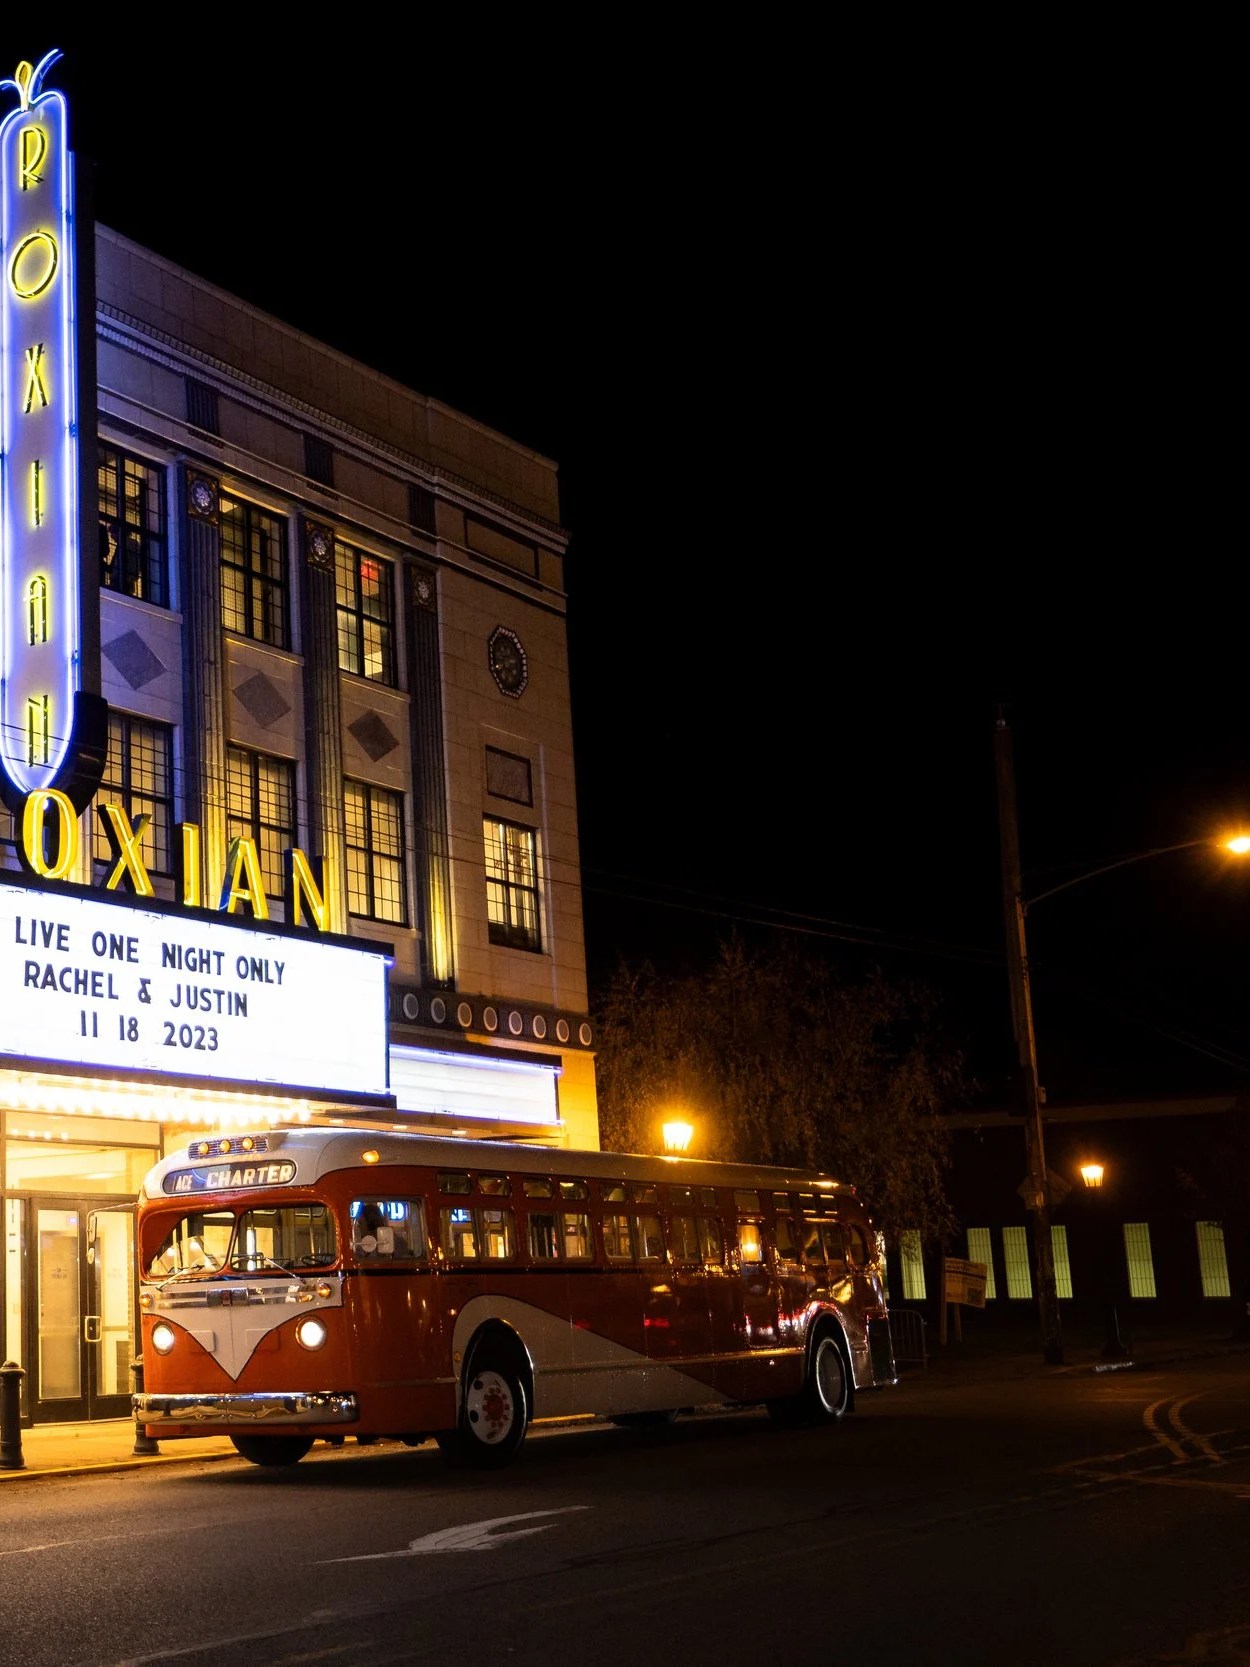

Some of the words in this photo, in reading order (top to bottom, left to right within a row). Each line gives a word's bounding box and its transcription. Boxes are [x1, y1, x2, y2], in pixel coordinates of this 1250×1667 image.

[7, 125, 58, 768] ROXIAN
[15, 916, 70, 952] LIVE
[92, 930, 139, 963] ONE
[162, 942, 225, 976] NIGHT
[236, 955, 285, 985] ONLY
[24, 959, 119, 1000] RACHEL
[138, 977, 151, 1004] &
[170, 983, 248, 1017] JUSTIN
[81, 1009, 98, 1038] 11
[119, 1014, 139, 1042] 18
[163, 1020, 219, 1051] 2023
[175, 1174, 193, 1191] ACE
[206, 1164, 293, 1189] CHARTER
